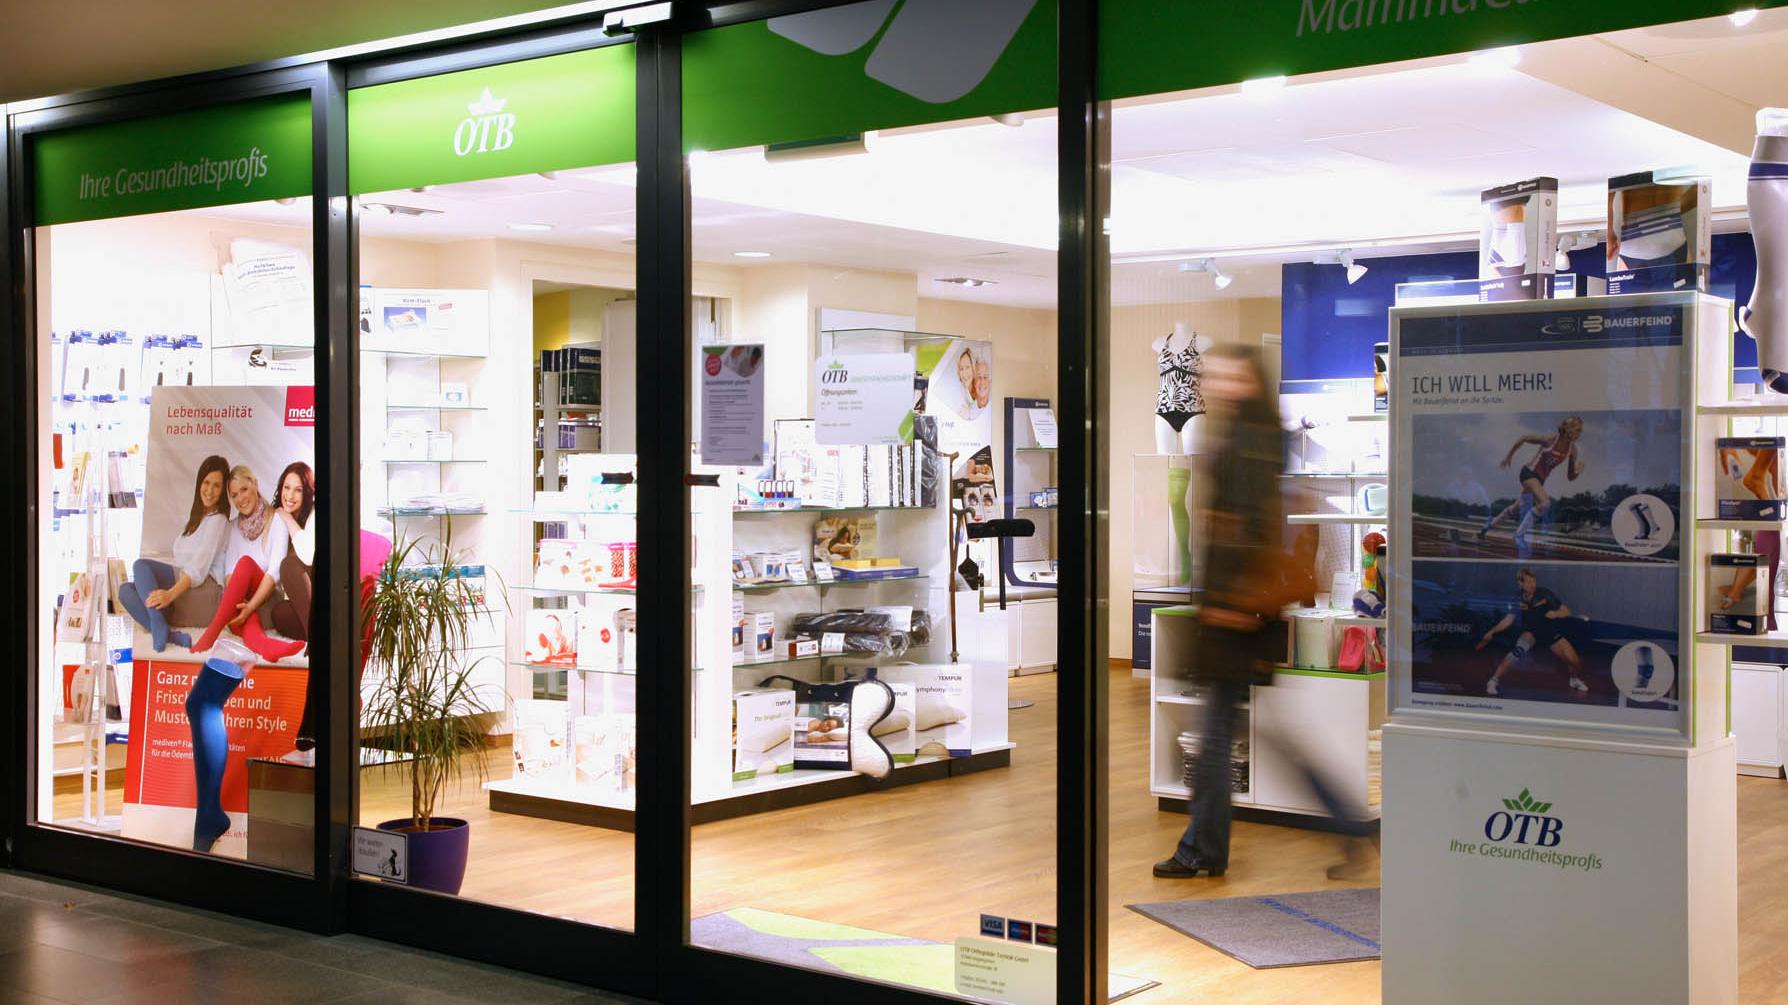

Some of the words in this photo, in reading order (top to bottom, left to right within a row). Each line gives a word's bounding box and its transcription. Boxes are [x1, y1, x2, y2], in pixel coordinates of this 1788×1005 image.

[454, 113, 516, 157] OTB
[80, 174, 111, 199] Ihre
[115, 147, 268, 196] Gesundheitsprofis
[1604, 315, 1673, 328] BAUERFEIND
[822, 370, 848, 384] OTB
[1412, 377, 1441, 394] ICH
[1449, 375, 1492, 393] WILL
[1498, 372, 1552, 392] MEHR!
[167, 405, 253, 420] Lebensqualität
[166, 423, 193, 435] nach
[196, 422, 222, 435] Maß
[157, 671, 188, 686] Ganz
[248, 696, 272, 710] und
[154, 710, 191, 725] Muste
[256, 716, 287, 733] Style
[1484, 811, 1563, 847] OTB
[1450, 839, 1476, 854] Ihre
[1479, 843, 1602, 871] Gesundheitsprofis
[984, 919, 1003, 930] VISA
